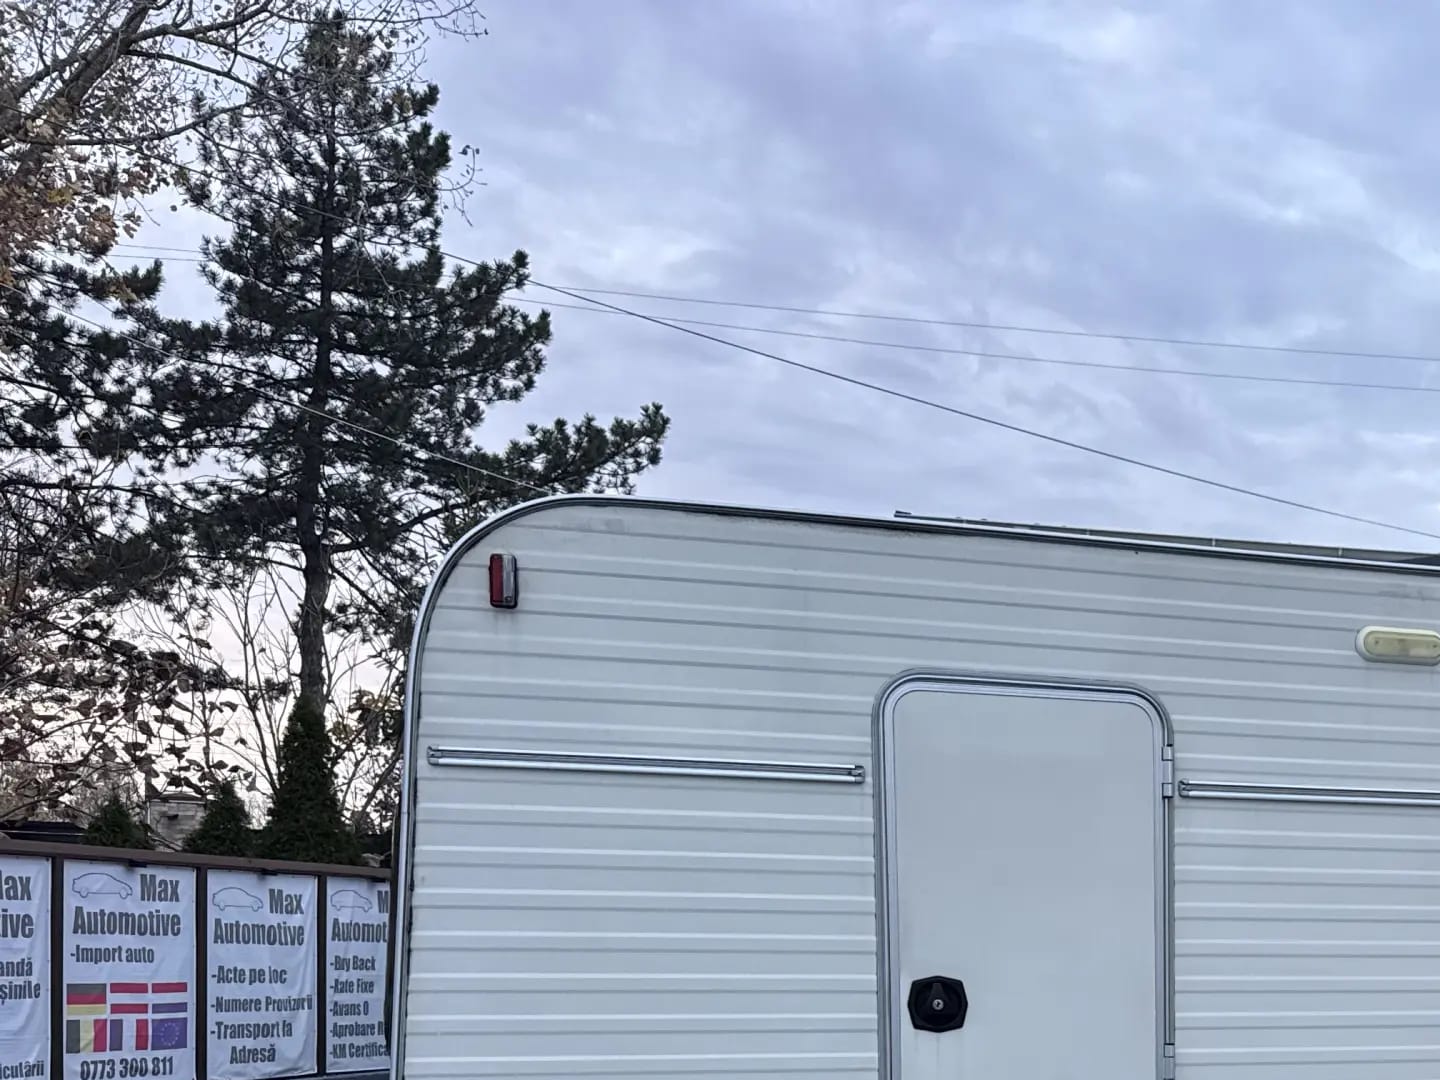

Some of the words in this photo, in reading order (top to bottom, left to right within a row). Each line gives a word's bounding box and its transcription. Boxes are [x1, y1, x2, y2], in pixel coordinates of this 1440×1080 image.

[0, 870, 32, 901] ax
[140, 873, 180, 902] Max
[268, 888, 304, 915] Max
[0, 908, 34, 938] ive
[72, 906, 181, 937] Automotive
[213, 918, 305, 946] Automotive
[125, 946, 155, 963] auto
[352, 955, 376, 971] Back
[248, 967, 266, 985] pe
[268, 965, 287, 984] loc
[356, 978, 375, 994] Fixe
[282, 1020, 293, 1038] la
[230, 1043, 276, 1064] Adresă
[80, 1058, 116, 1080] 0773
[119, 1057, 149, 1079] 300
[151, 1056, 173, 1077] 811
